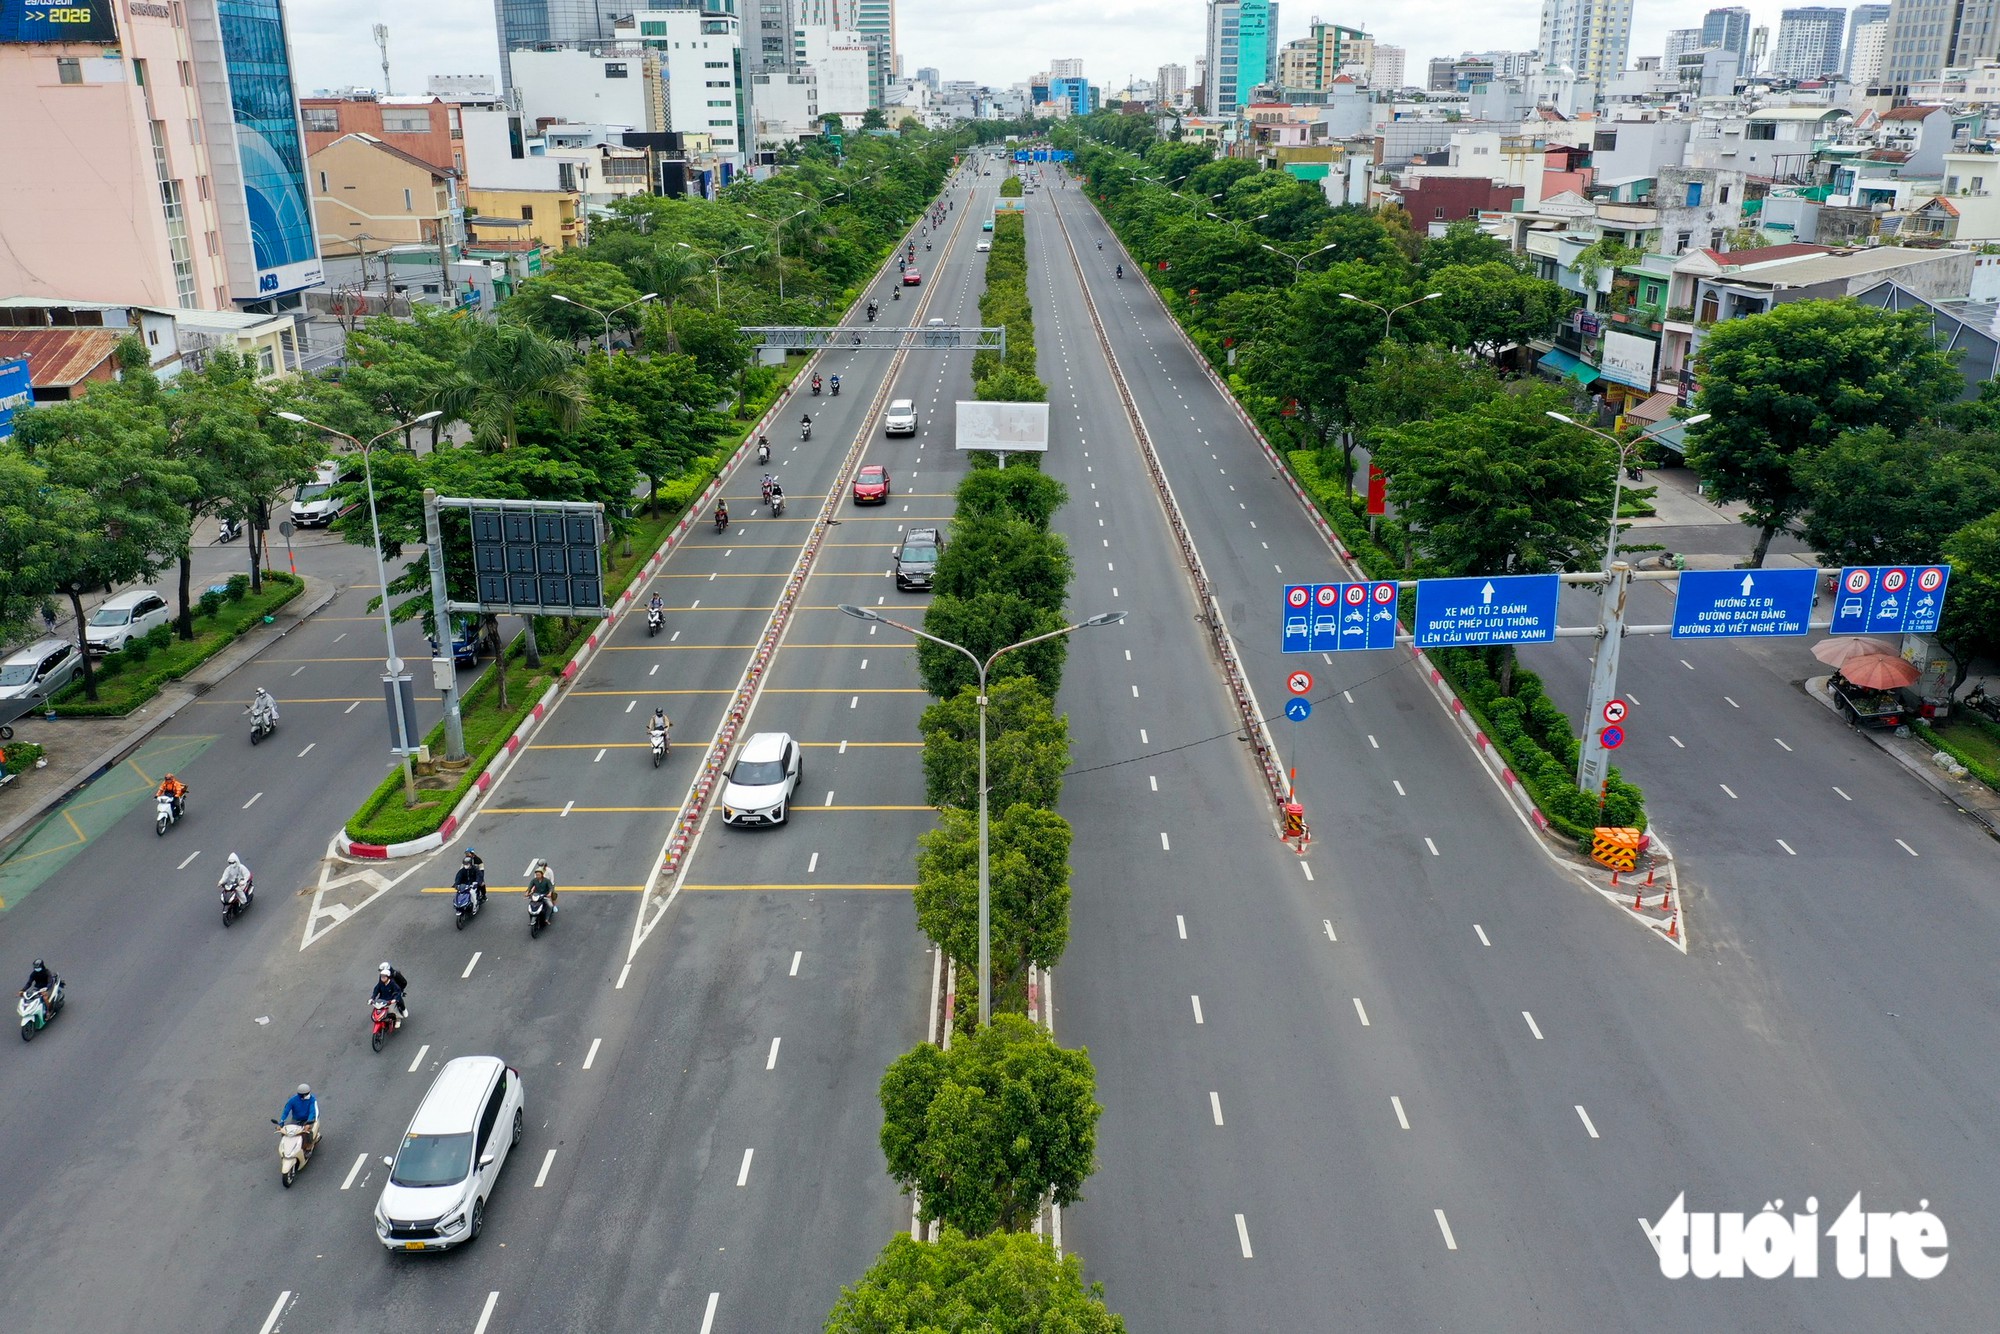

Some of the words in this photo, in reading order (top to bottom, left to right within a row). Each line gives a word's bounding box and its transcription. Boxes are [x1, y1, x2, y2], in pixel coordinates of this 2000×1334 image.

[49, 8, 91, 23] 2026
[259, 273, 279, 293] ACB
[1852, 575, 1863, 588] 60
[1888, 574, 1900, 587] 60
[1924, 573, 1936, 586] 60
[1292, 593, 1302, 602] 60
[1321, 592, 1331, 601] 60
[1350, 589, 1360, 600] 60
[1378, 588, 1388, 599] 60
[1714, 597, 1747, 608] HƯỚNG
[1749, 598, 1761, 607] XE
[1764, 597, 1774, 607] ĐI
[1445, 608, 1457, 616] XE
[1460, 605, 1475, 616] MÔ
[1478, 605, 1490, 615] TÔ
[1493, 606, 1498, 615] 2
[1501, 603, 1527, 614] BÁNH
[1698, 609, 1731, 620] ĐƯỜNG
[1734, 610, 1758, 621] BẠCH
[1429, 620, 1455, 631] ĐƯỢC
[1458, 617, 1482, 628] PHÉP
[1485, 618, 1504, 628] LƯU
[1507, 616, 1539, 626] THÔNG
[1678, 622, 1711, 634] ĐƯỜNG
[1713, 622, 1726, 633] XÔ
[1728, 619, 1748, 633] VIẾT
[1750, 621, 1777, 633] NGHỆ
[1778, 621, 1799, 632] TĨNH
[1422, 632, 1440, 643] LÊN
[1465, 631, 1489, 642] VƯỢT
[1492, 629, 1518, 640] HÀNG
[1520, 629, 1546, 639] XANH
